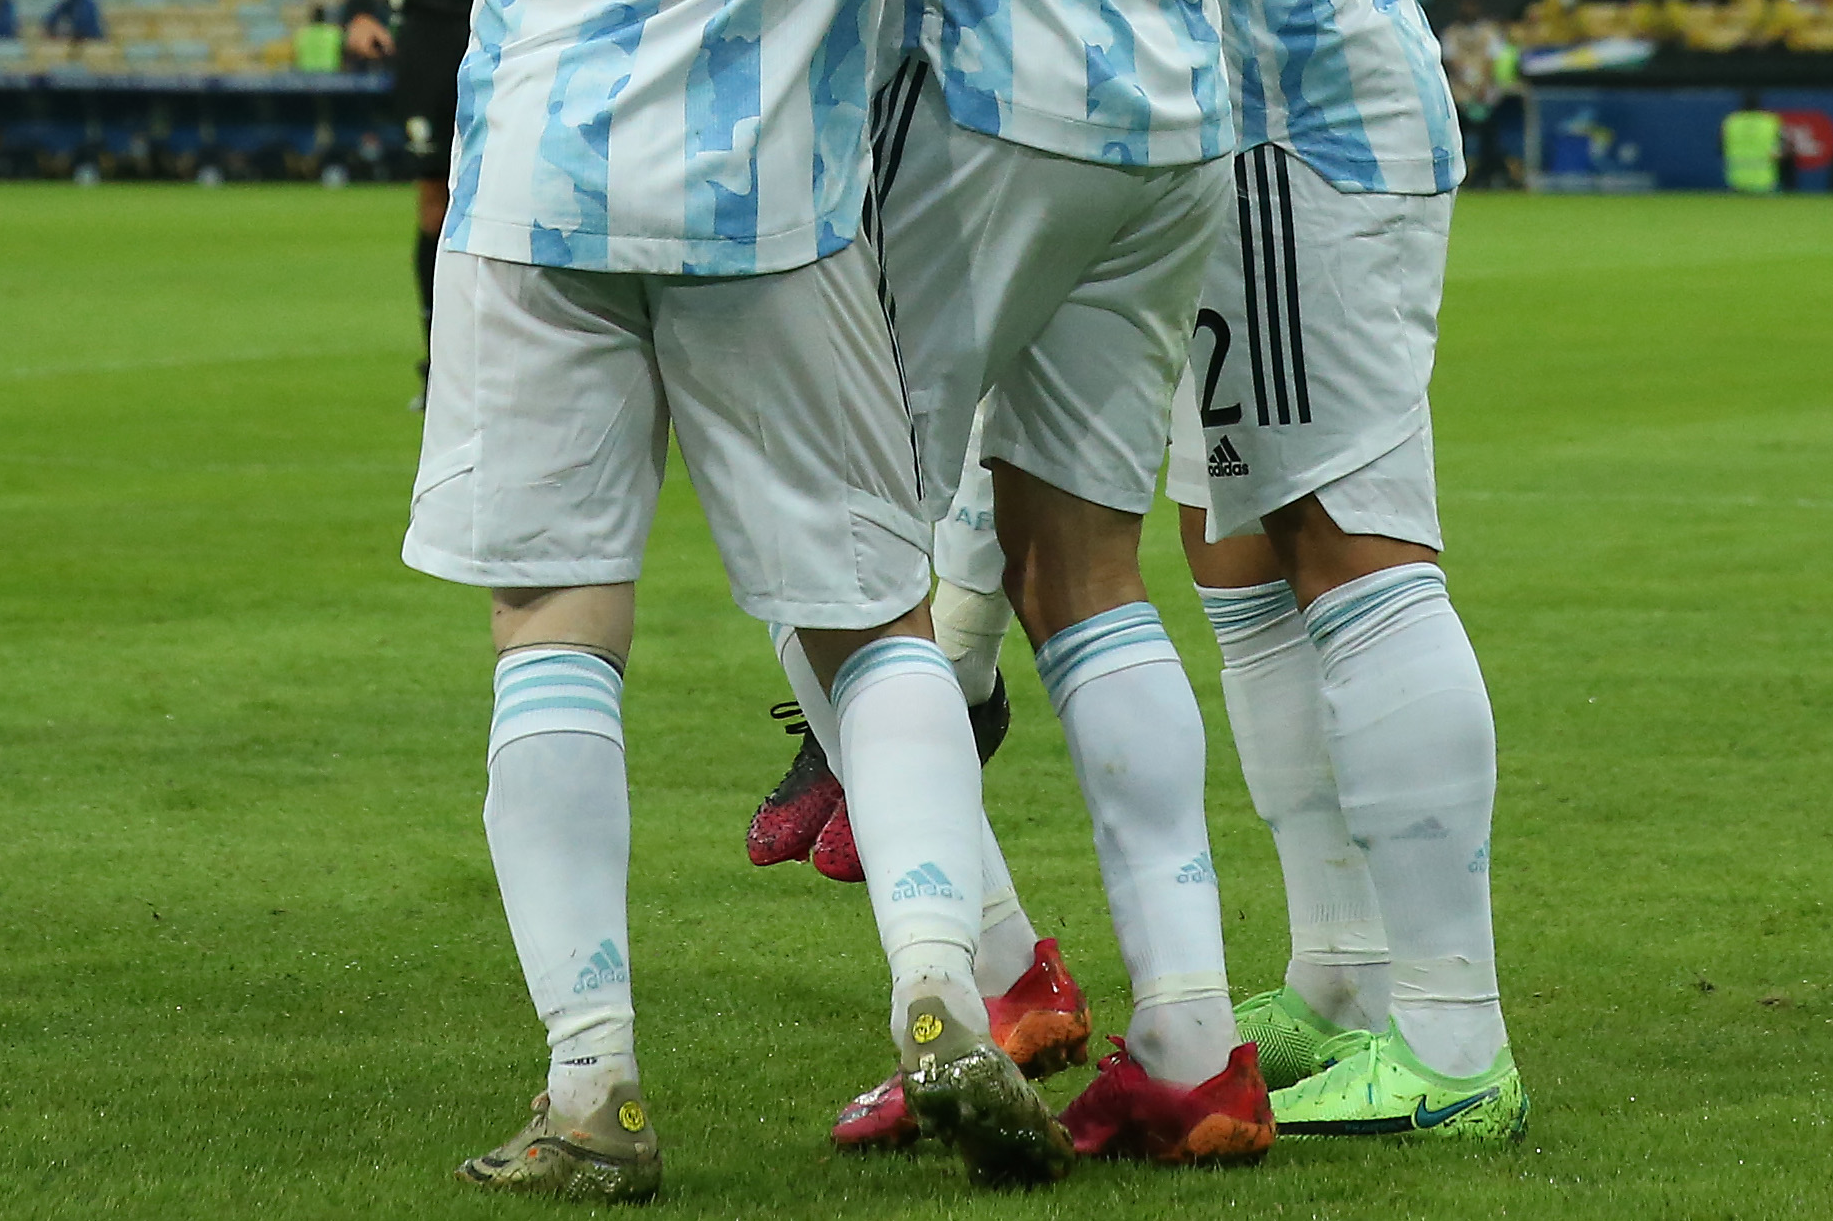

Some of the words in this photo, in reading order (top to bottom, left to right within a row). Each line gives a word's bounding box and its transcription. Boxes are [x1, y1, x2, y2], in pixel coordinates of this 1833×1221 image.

[1192, 308, 1242, 428] 2
[1208, 461, 1249, 477] adidas
[955, 507, 994, 530] AF
